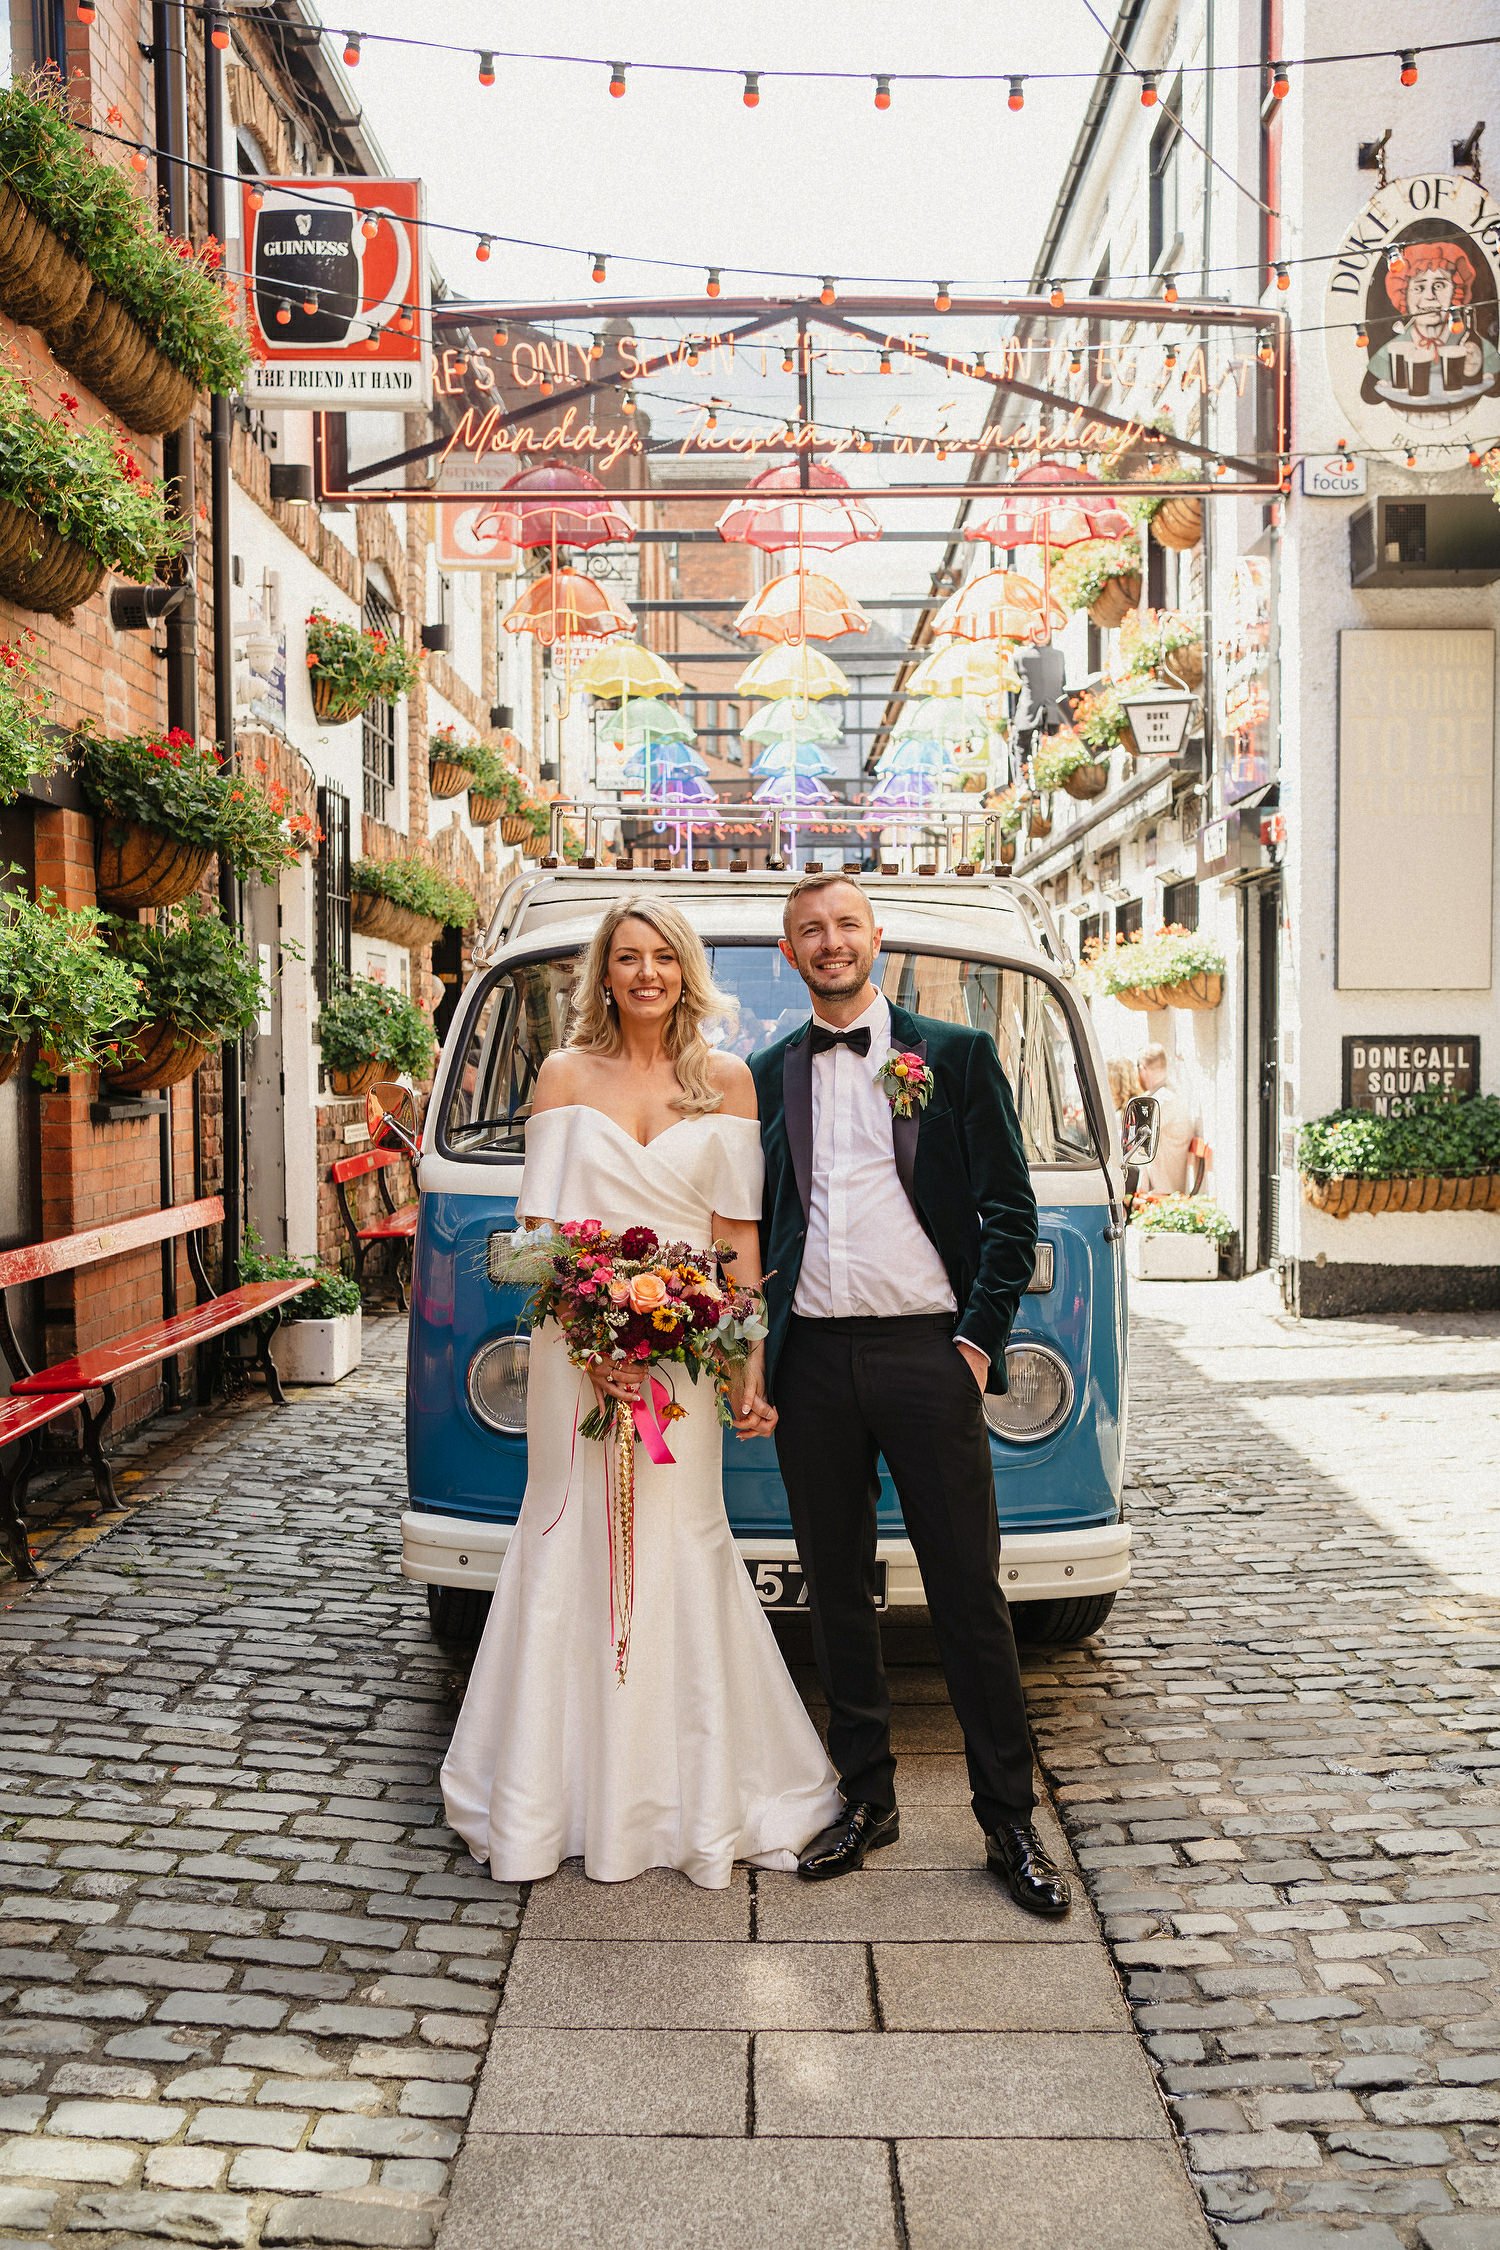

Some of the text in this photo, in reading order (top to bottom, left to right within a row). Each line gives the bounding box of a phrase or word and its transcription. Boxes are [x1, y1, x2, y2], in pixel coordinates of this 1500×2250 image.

[1331, 200, 1398, 295] DUKE
[1408, 179, 1454, 211] OF
[263, 240, 349, 257] GUINNESS
[511, 341, 595, 387] ONLY
[254, 369, 412, 390] THE FRIEND AT HAND
[440, 405, 643, 470] Monday,
[1313, 474, 1359, 490] focus
[1147, 712, 1170, 721] DUKE
[1368, 1071, 1455, 1095] SQUARE
